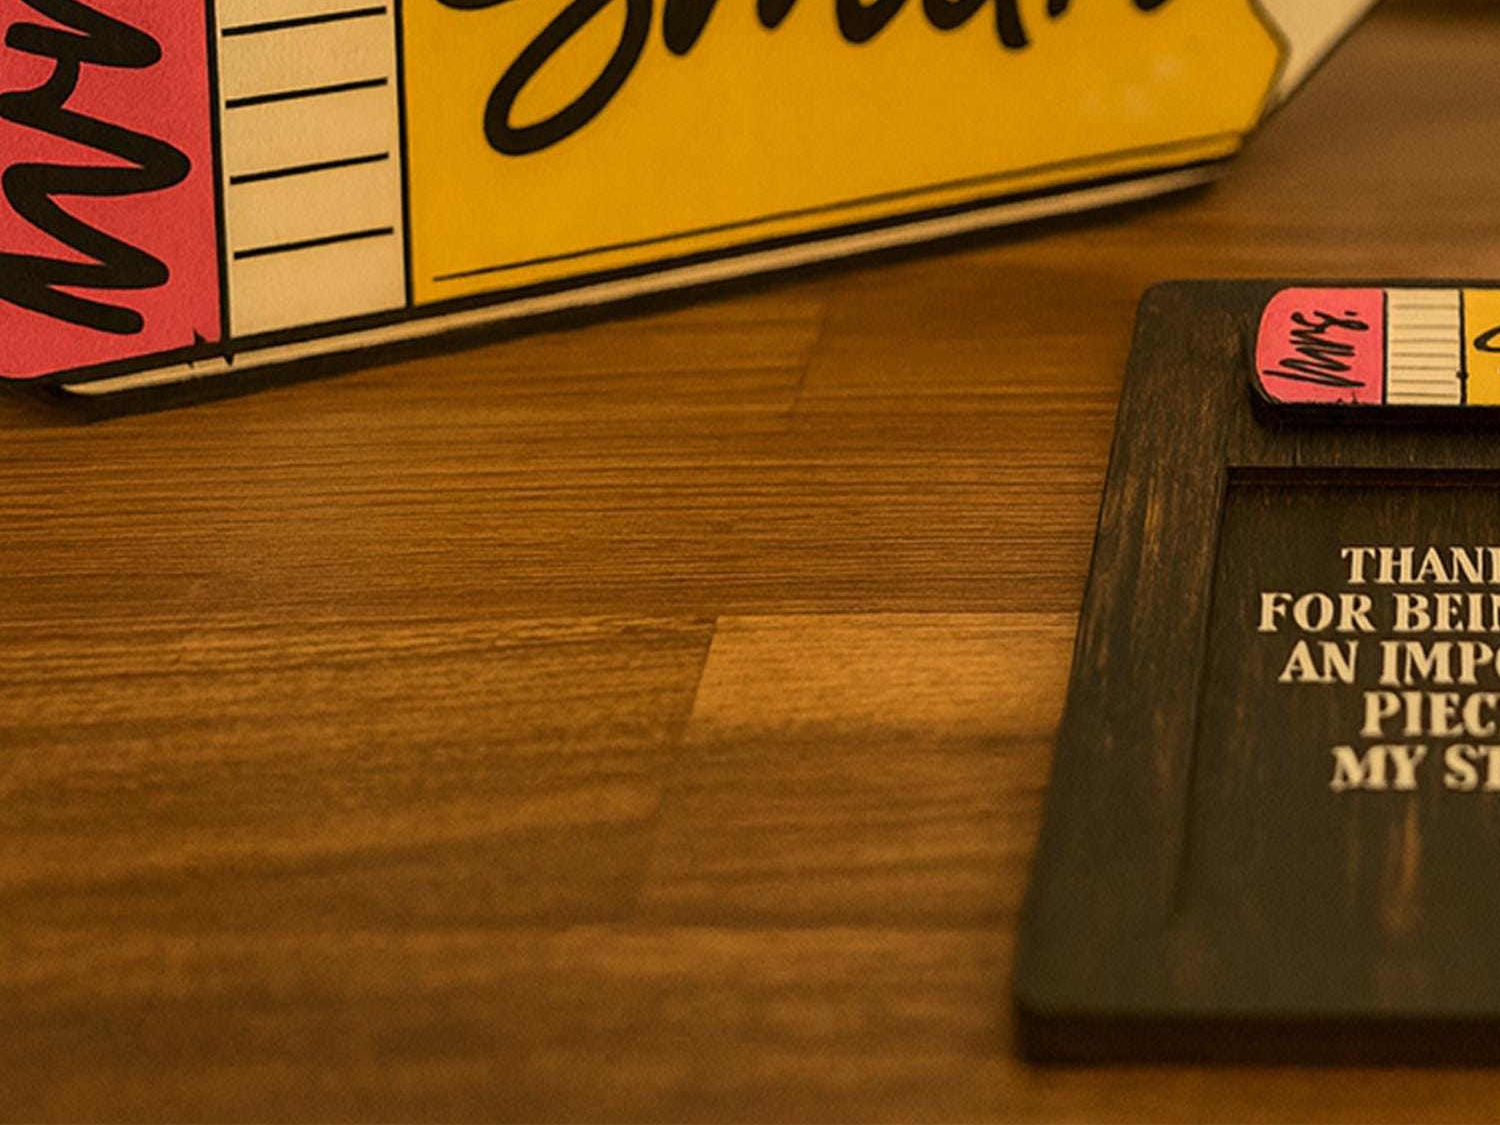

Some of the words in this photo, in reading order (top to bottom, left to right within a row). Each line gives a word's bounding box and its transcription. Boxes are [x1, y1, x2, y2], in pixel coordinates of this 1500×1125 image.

[1257, 593, 1373, 634] FOR
[1278, 641, 1365, 685] AN
[1330, 745, 1425, 792] MY
